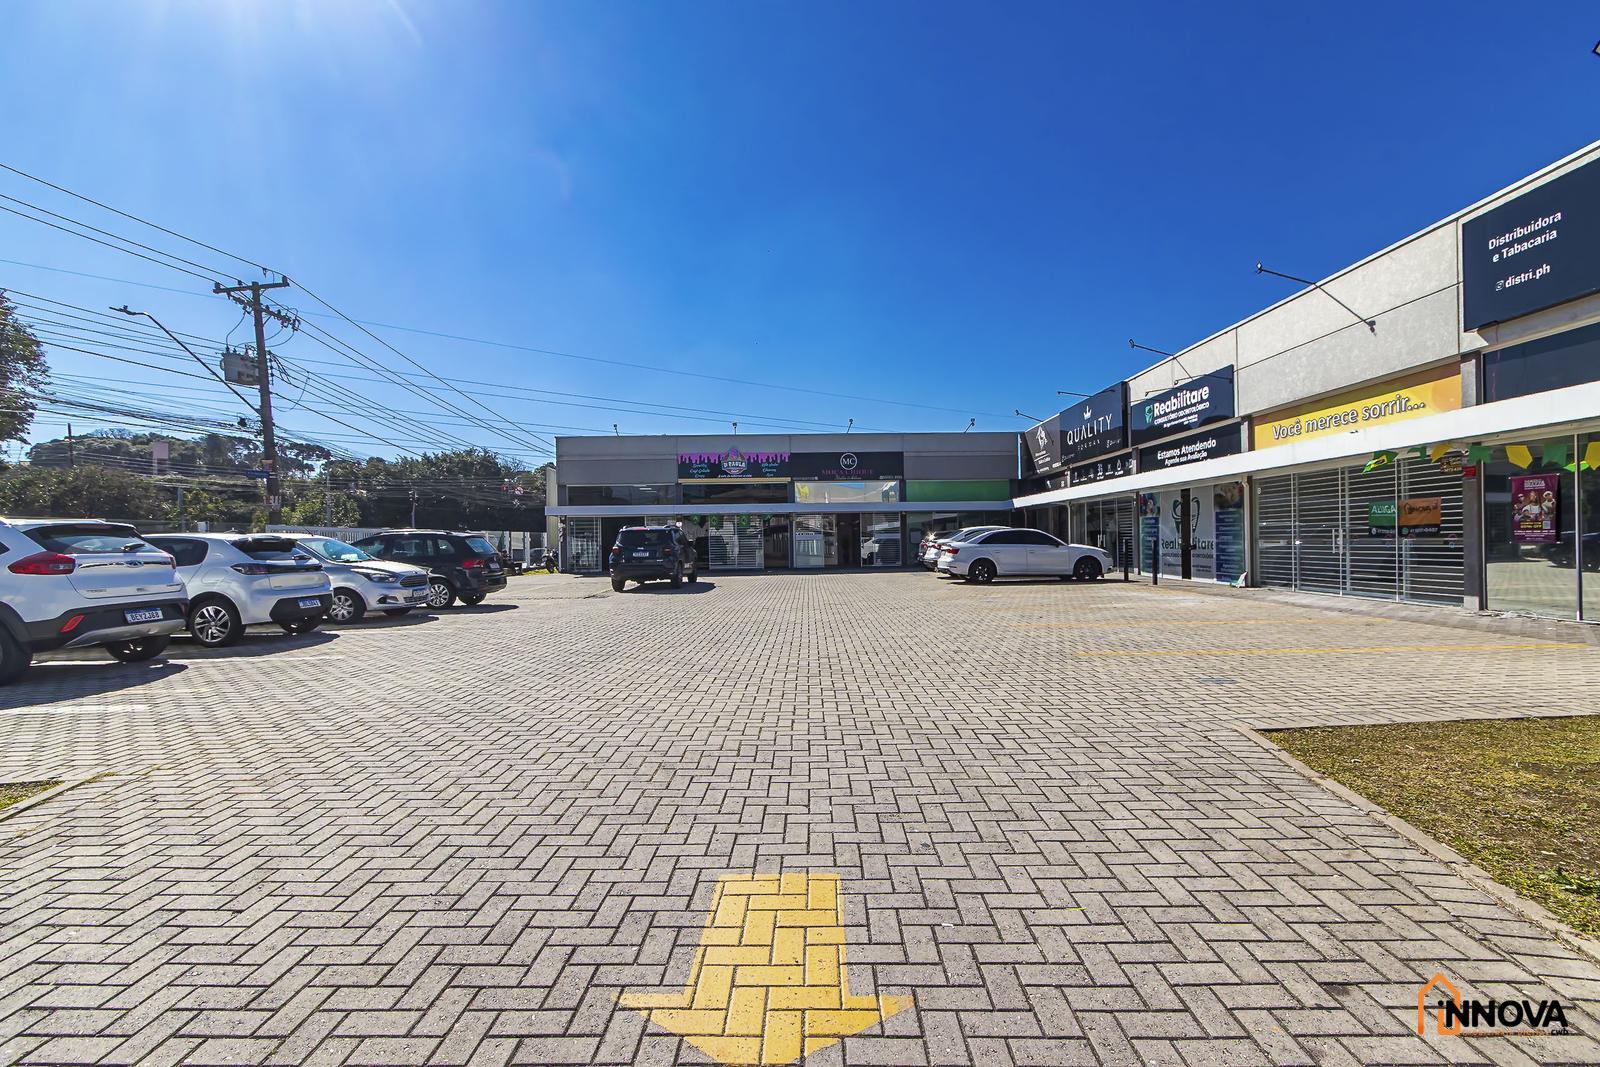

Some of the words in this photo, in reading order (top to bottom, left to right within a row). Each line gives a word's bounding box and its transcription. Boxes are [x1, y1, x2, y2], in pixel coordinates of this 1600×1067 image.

[1488, 211, 1561, 250] Distribuidora
[1492, 253, 1499, 262] e
[1501, 229, 1557, 259] Tabacaria
[1153, 386, 1209, 417] Reabilitare
[1272, 419, 1302, 439] Você
[1305, 408, 1358, 433] merece
[1362, 394, 1425, 421] sorrir...
[1066, 413, 1112, 445] QUALITY
[1157, 448, 1180, 460] Estamos
[1181, 437, 1217, 455] Atendendo
